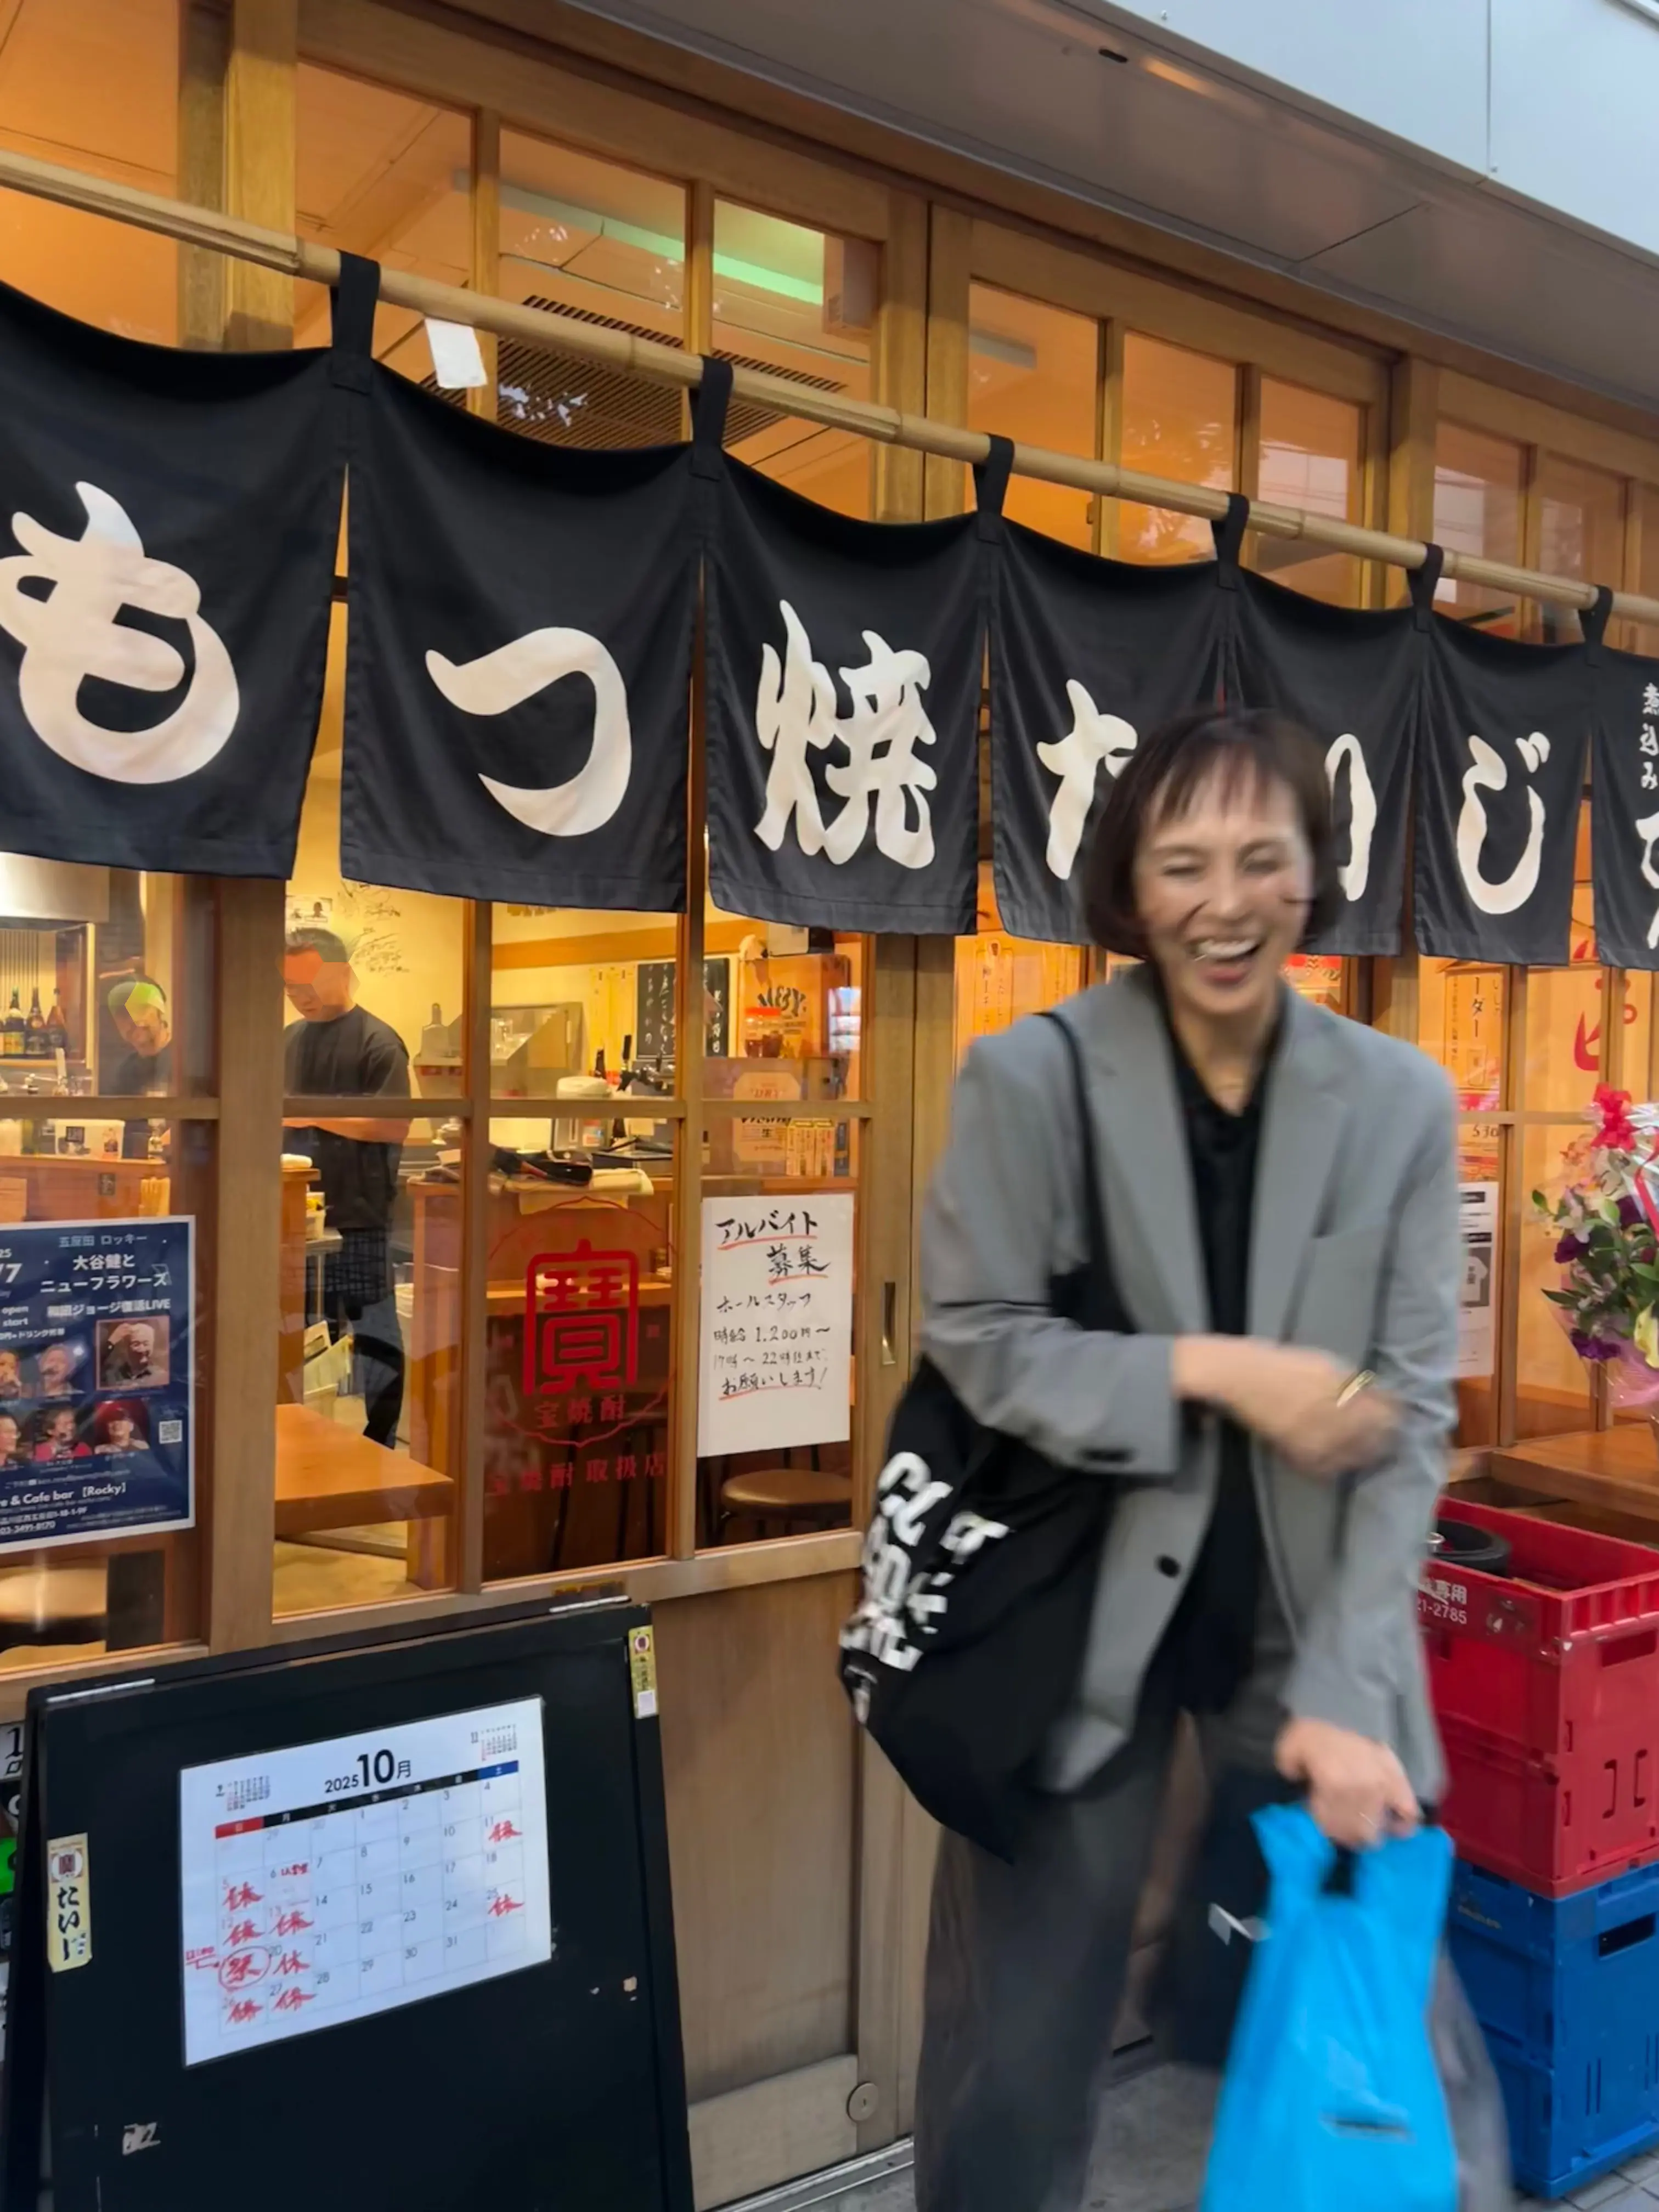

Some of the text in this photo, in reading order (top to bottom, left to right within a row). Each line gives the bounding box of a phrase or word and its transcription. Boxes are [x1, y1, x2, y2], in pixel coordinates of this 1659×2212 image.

[101, 1234, 147, 1246] ロッキー
[715, 1210, 818, 1244] アルバイト
[767, 1243, 831, 1277] 募集
[40, 1272, 168, 1293] ニューフラワーズ
[2, 1306, 29, 1316] open
[716, 1293, 811, 1312] ホールスタッフ
[714, 1327, 746, 1344] 時給
[23, 1492, 50, 1505] Cafe
[53, 1490, 75, 1502] bar
[324, 1748, 412, 1793] 2025 10月
[402, 1799, 409, 1810] 2
[443, 1791, 450, 1801] 3
[484, 1781, 490, 1790] 4
[282, 1813, 291, 1822] 月
[270, 1869, 277, 1878] 6
[360, 1846, 368, 1857] 8
[403, 1836, 410, 1846] 9
[444, 1826, 455, 1837] 10
[315, 1895, 328, 1906] 14
[360, 1883, 373, 1895] 15
[404, 1874, 415, 1884] 16
[445, 1863, 456, 1874] 17
[486, 1852, 497, 1863] 18
[315, 1933, 327, 1945] 21
[360, 1921, 373, 1934] 22
[403, 1910, 416, 1922] 23
[445, 1899, 458, 1910] 24
[316, 1971, 330, 1984] 28
[405, 1948, 417, 1959] 30
[446, 1936, 458, 1948] 31
